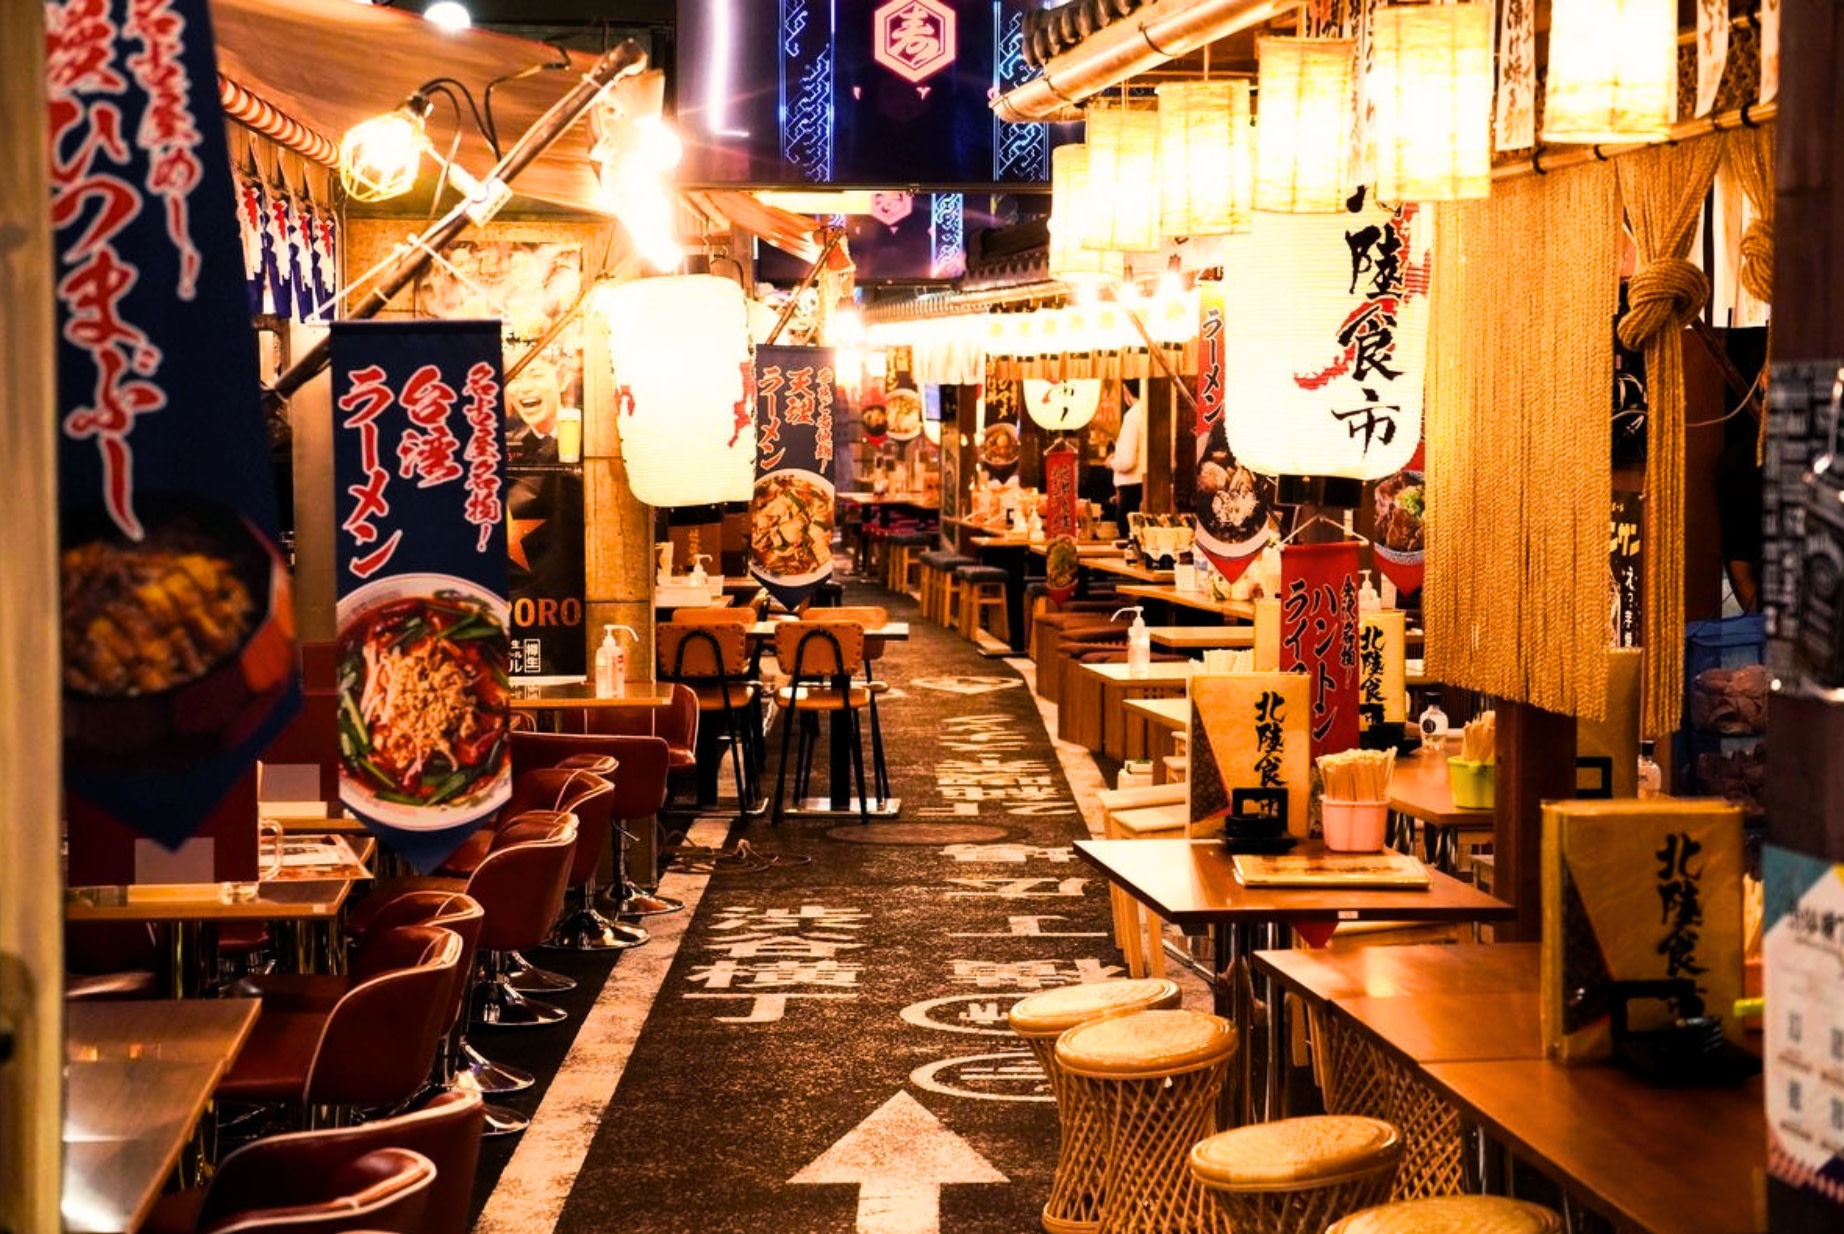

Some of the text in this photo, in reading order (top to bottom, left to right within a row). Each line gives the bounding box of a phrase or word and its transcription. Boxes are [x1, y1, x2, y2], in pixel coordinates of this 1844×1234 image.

[1202, 308, 1225, 424] ラーメン
[1331, 184, 1404, 458] 陸食市
[397, 363, 464, 489] 台湾
[757, 365, 787, 471] ラーメン
[785, 366, 816, 426] 天理
[338, 364, 403, 579] ラーメン
[508, 597, 583, 628] ORO
[1310, 583, 1339, 742] ハントン
[1360, 625, 1389, 724] 北陸食
[681, 904, 873, 1024] 渋谷横丁
[1655, 832, 1711, 1012] 北陸食
